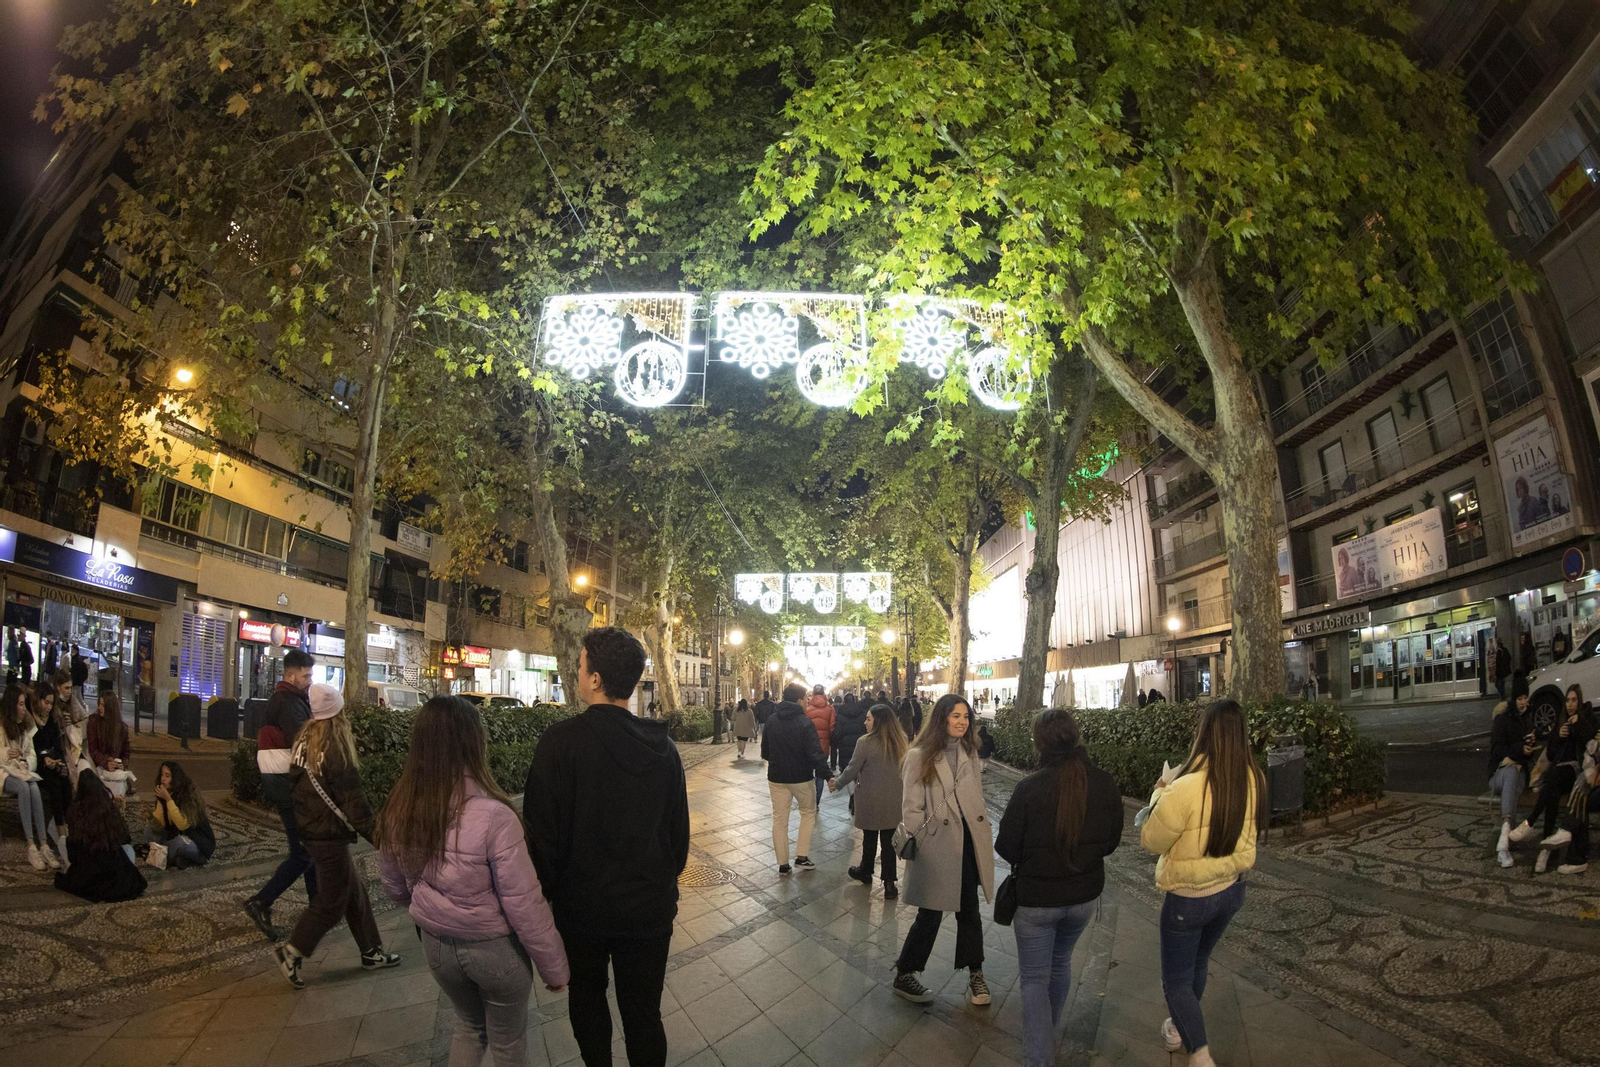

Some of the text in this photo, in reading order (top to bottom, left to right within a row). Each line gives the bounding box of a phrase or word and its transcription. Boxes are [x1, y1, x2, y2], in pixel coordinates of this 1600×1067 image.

[1511, 445, 1547, 473] HIJA
[1404, 533, 1414, 541] LA
[1393, 540, 1431, 566] HIJA
[85, 559, 104, 578] La
[105, 562, 135, 586] Rosa
[40, 586, 93, 608] PIONONOS
[1293, 612, 1365, 636] CINE MADRIGAL
